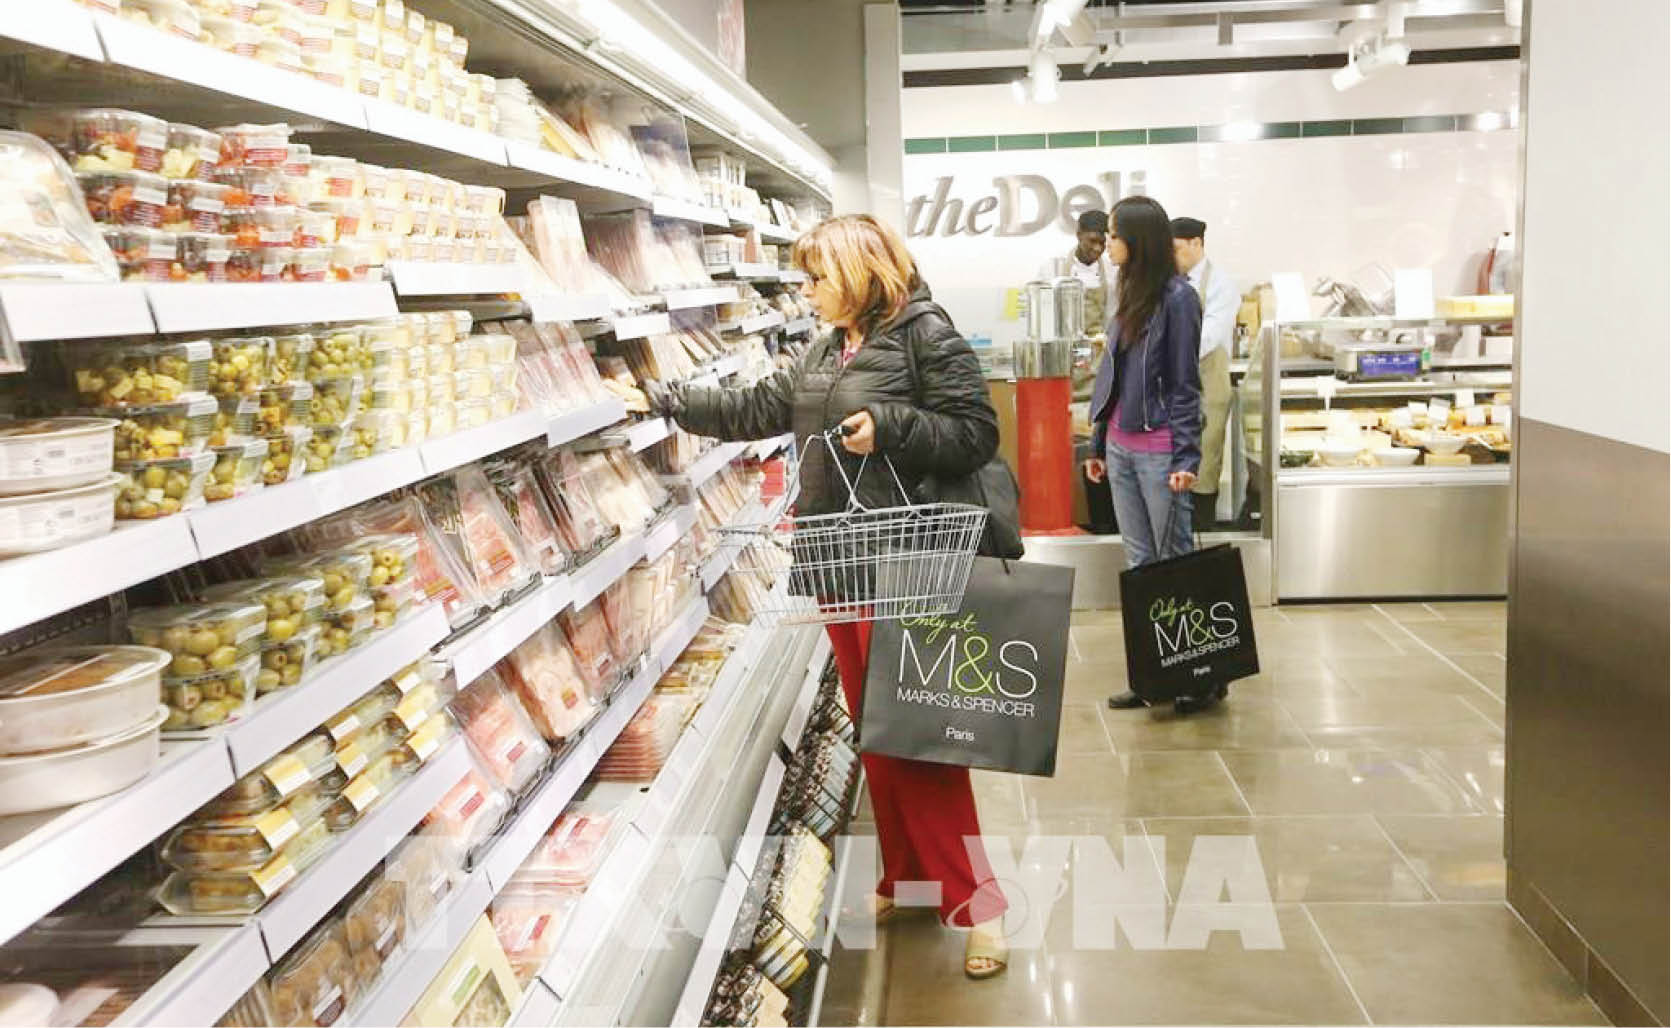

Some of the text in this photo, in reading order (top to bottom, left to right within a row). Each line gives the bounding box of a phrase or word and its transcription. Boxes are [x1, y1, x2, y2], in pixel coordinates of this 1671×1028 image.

[1154, 601, 1238, 657] M&S
[898, 629, 1038, 699] M&S
[896, 686, 950, 709] MARKS
[963, 695, 1036, 717] SPENCER
[945, 726, 975, 742] Paris
